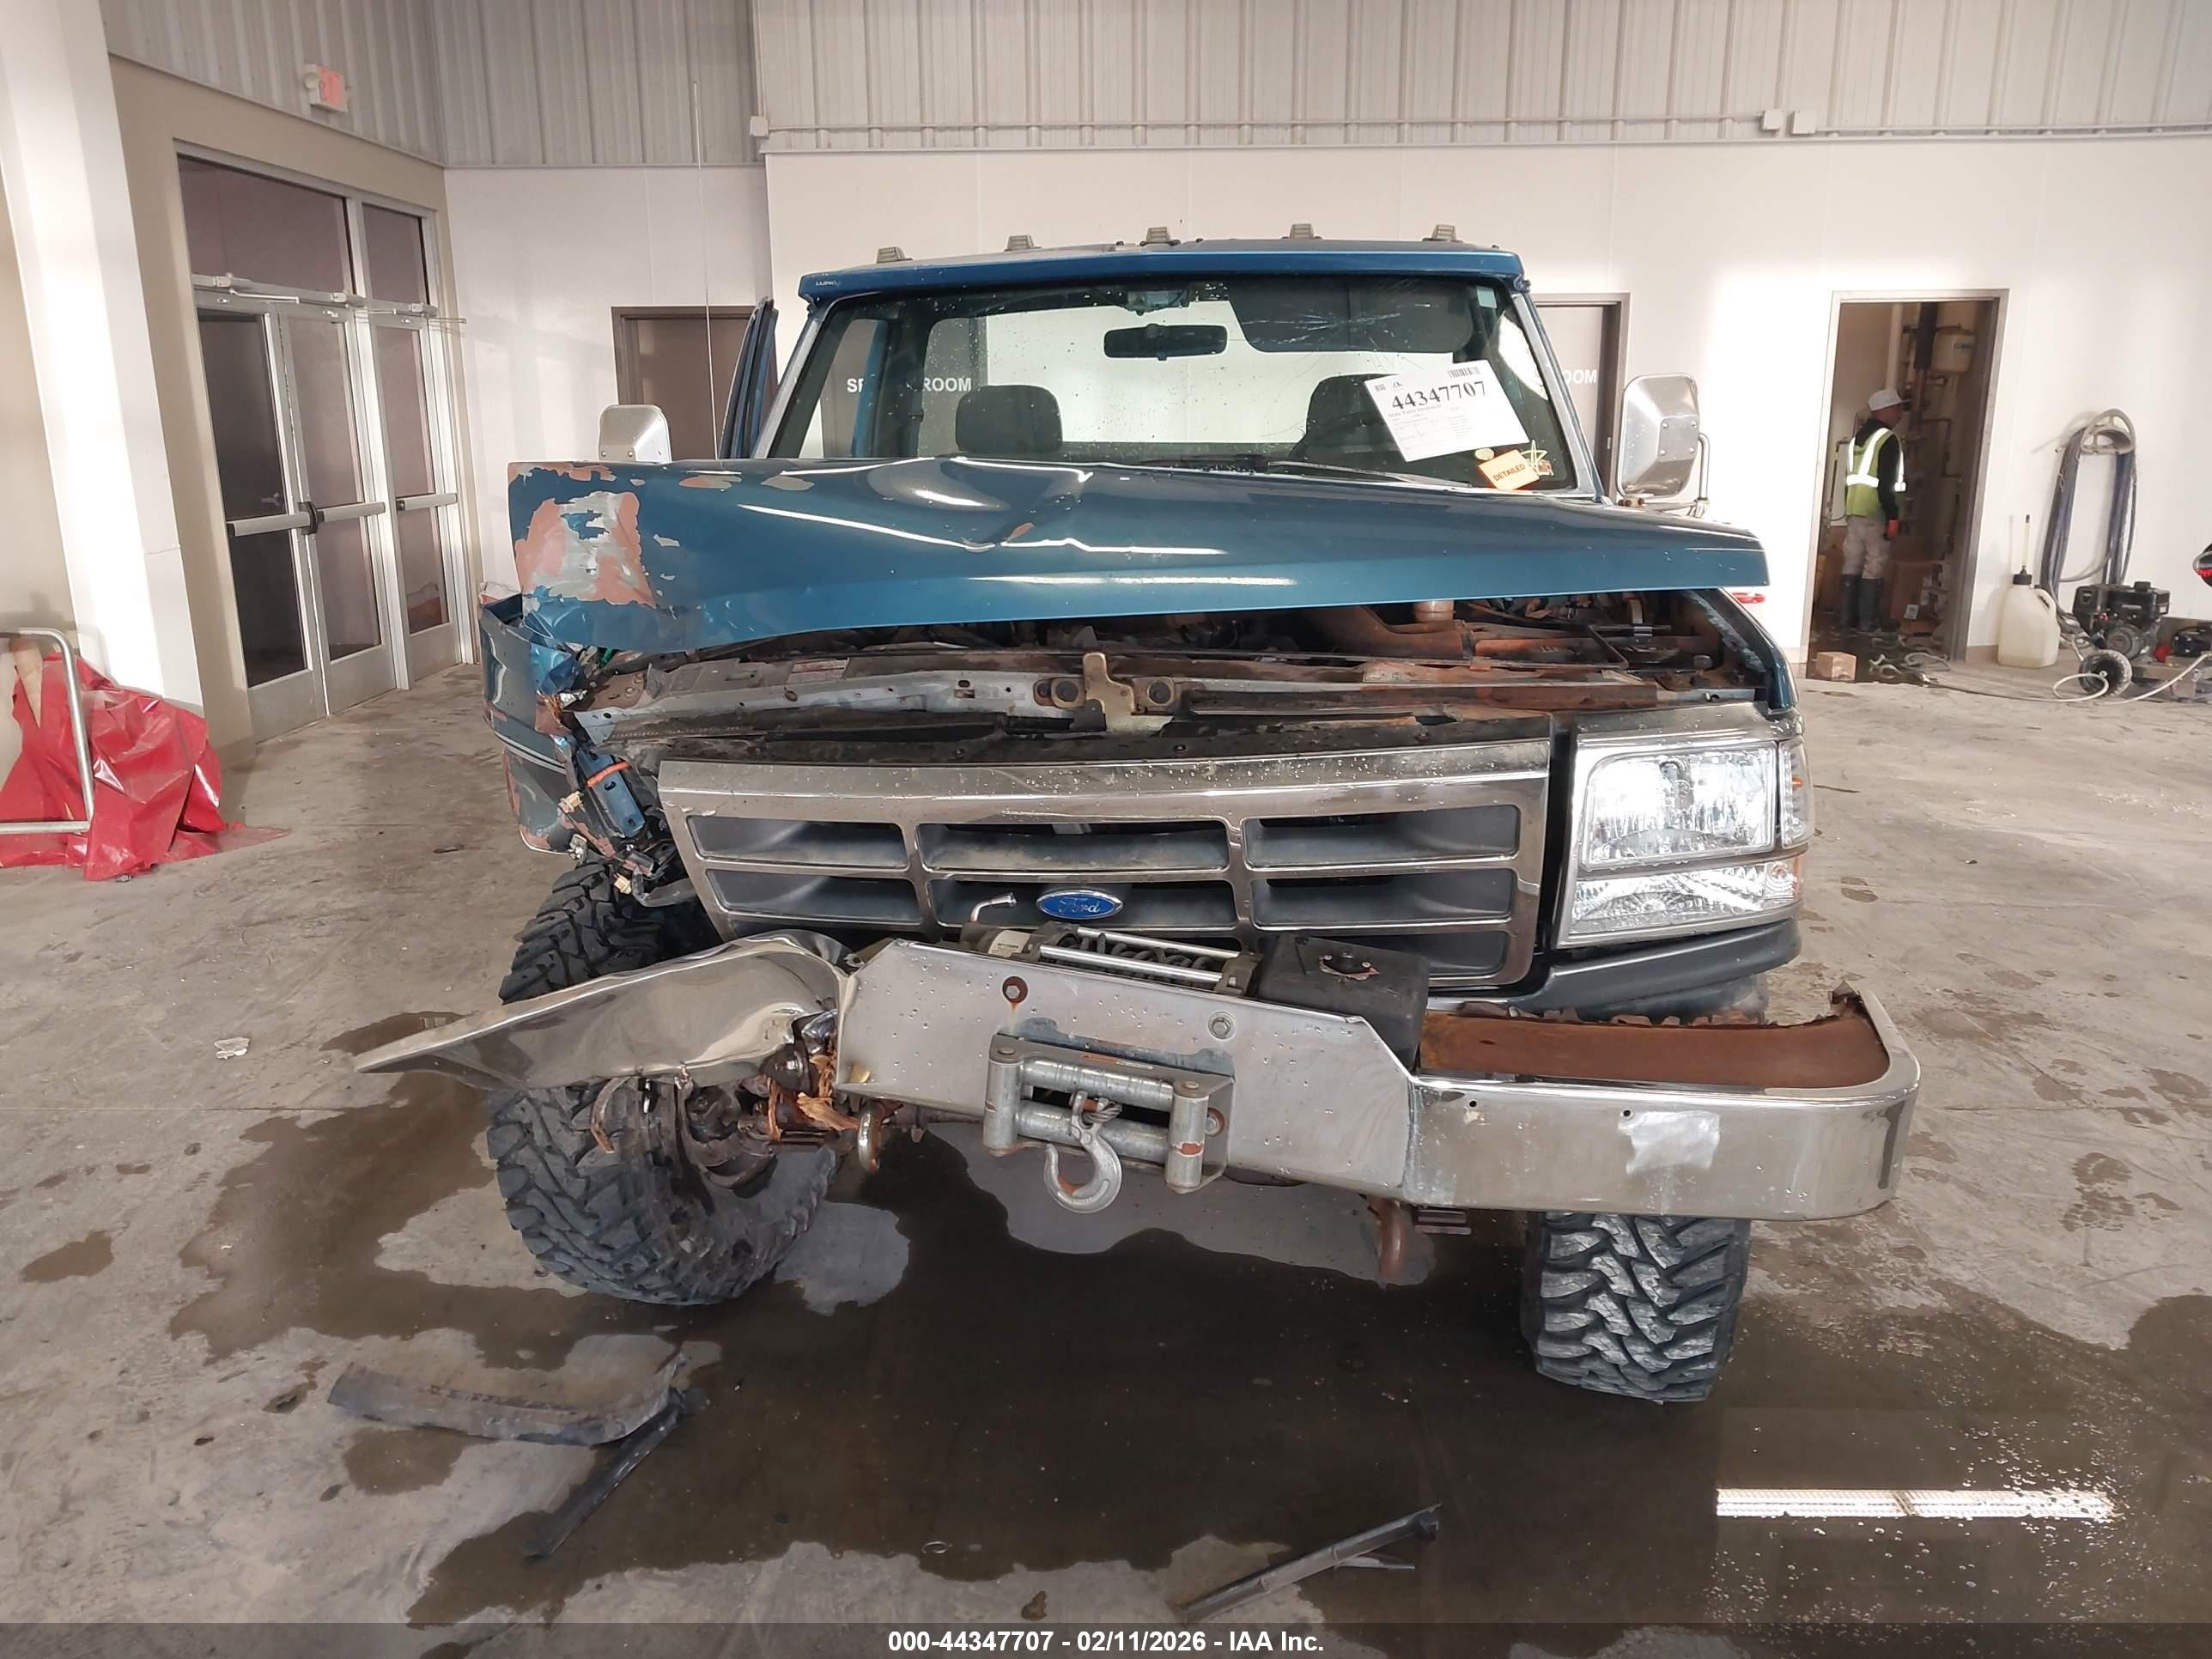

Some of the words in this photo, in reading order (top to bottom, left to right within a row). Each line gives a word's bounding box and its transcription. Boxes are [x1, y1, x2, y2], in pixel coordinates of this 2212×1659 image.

[923, 377, 972, 392] ROOM
[1562, 369, 1597, 384] OOM
[1392, 381, 1486, 410] 44347707
[1492, 464, 1526, 482] DETAILED
[1057, 897, 1101, 915] Ford
